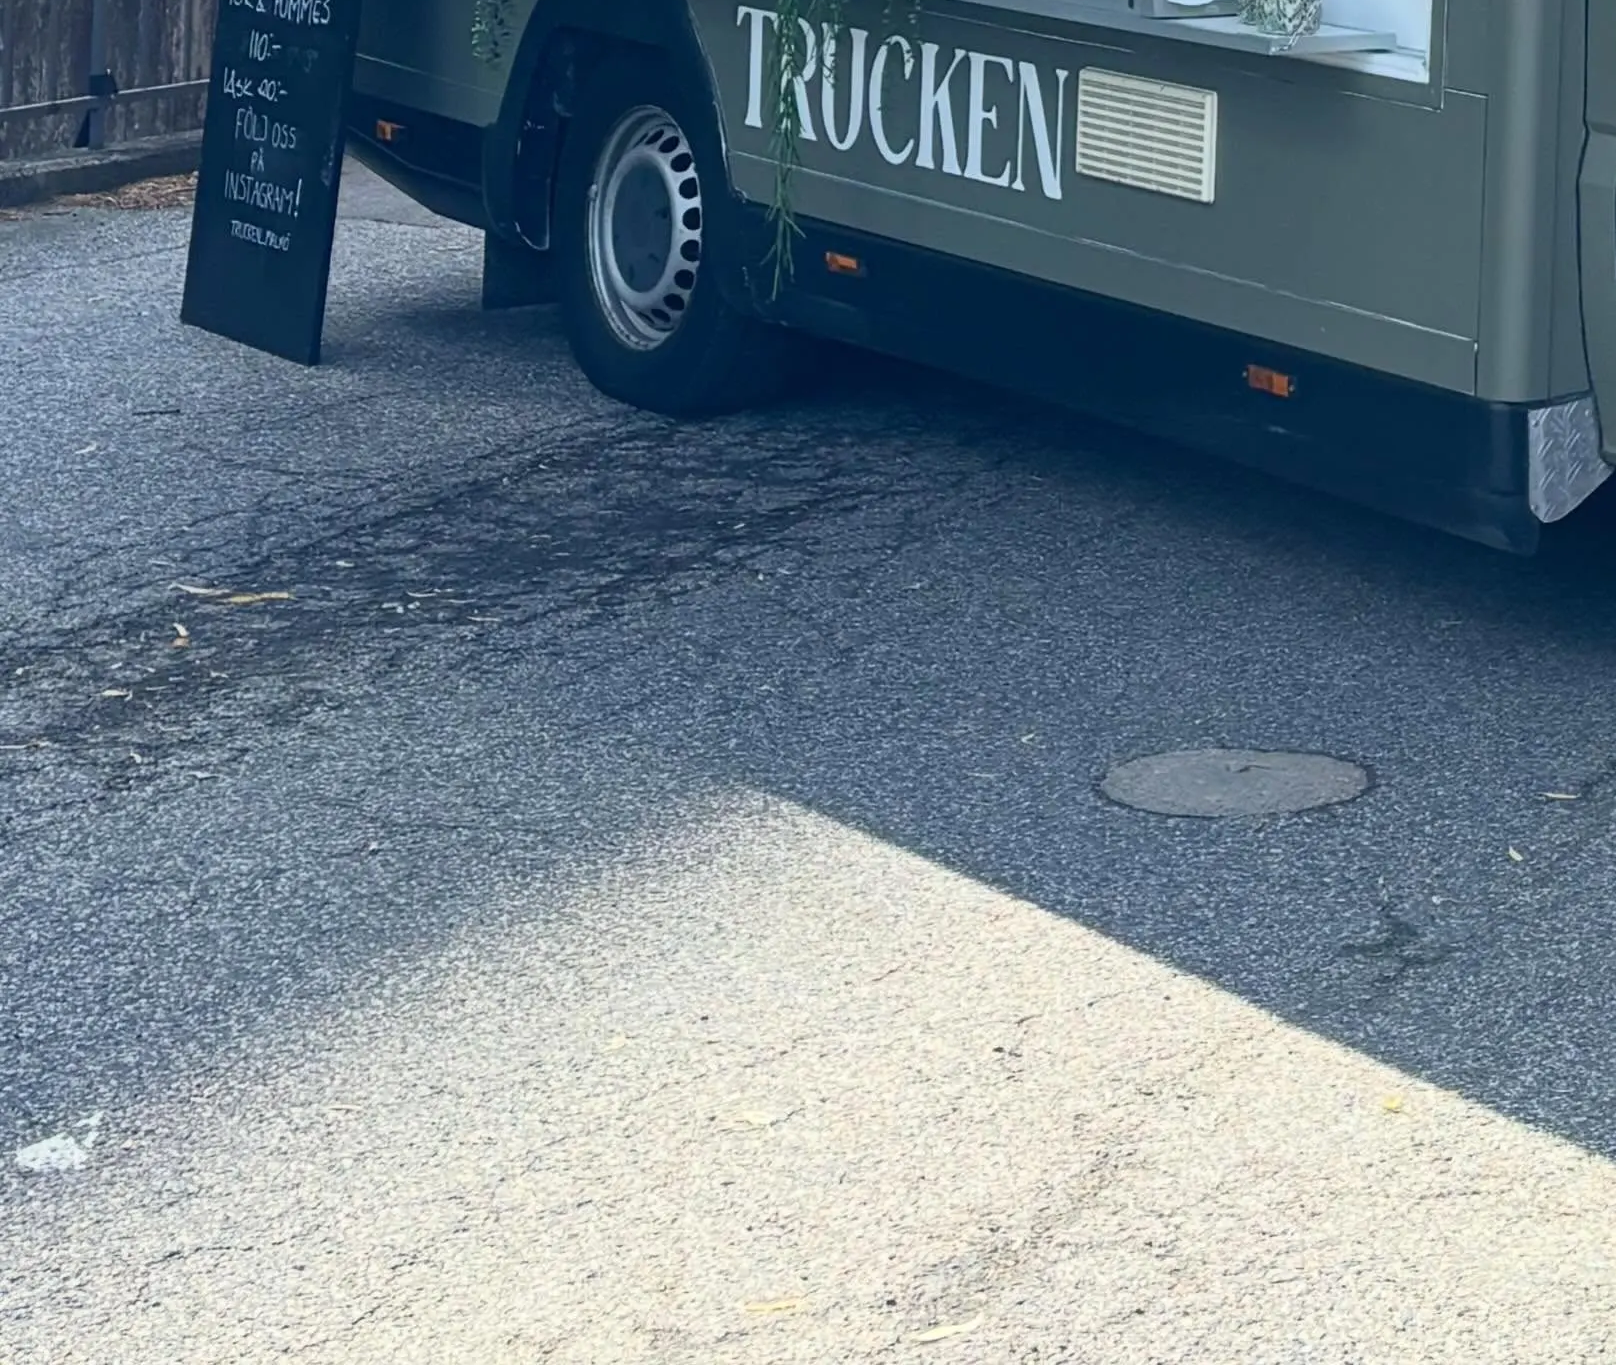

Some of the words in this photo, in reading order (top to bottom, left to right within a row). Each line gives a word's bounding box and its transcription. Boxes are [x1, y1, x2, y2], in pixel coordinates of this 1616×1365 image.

[736, 5, 1070, 201] TRUCKEN
[271, 122, 297, 149] OSS
[250, 147, 265, 173] PÅ
[224, 169, 303, 219] INSTAGRAM!
